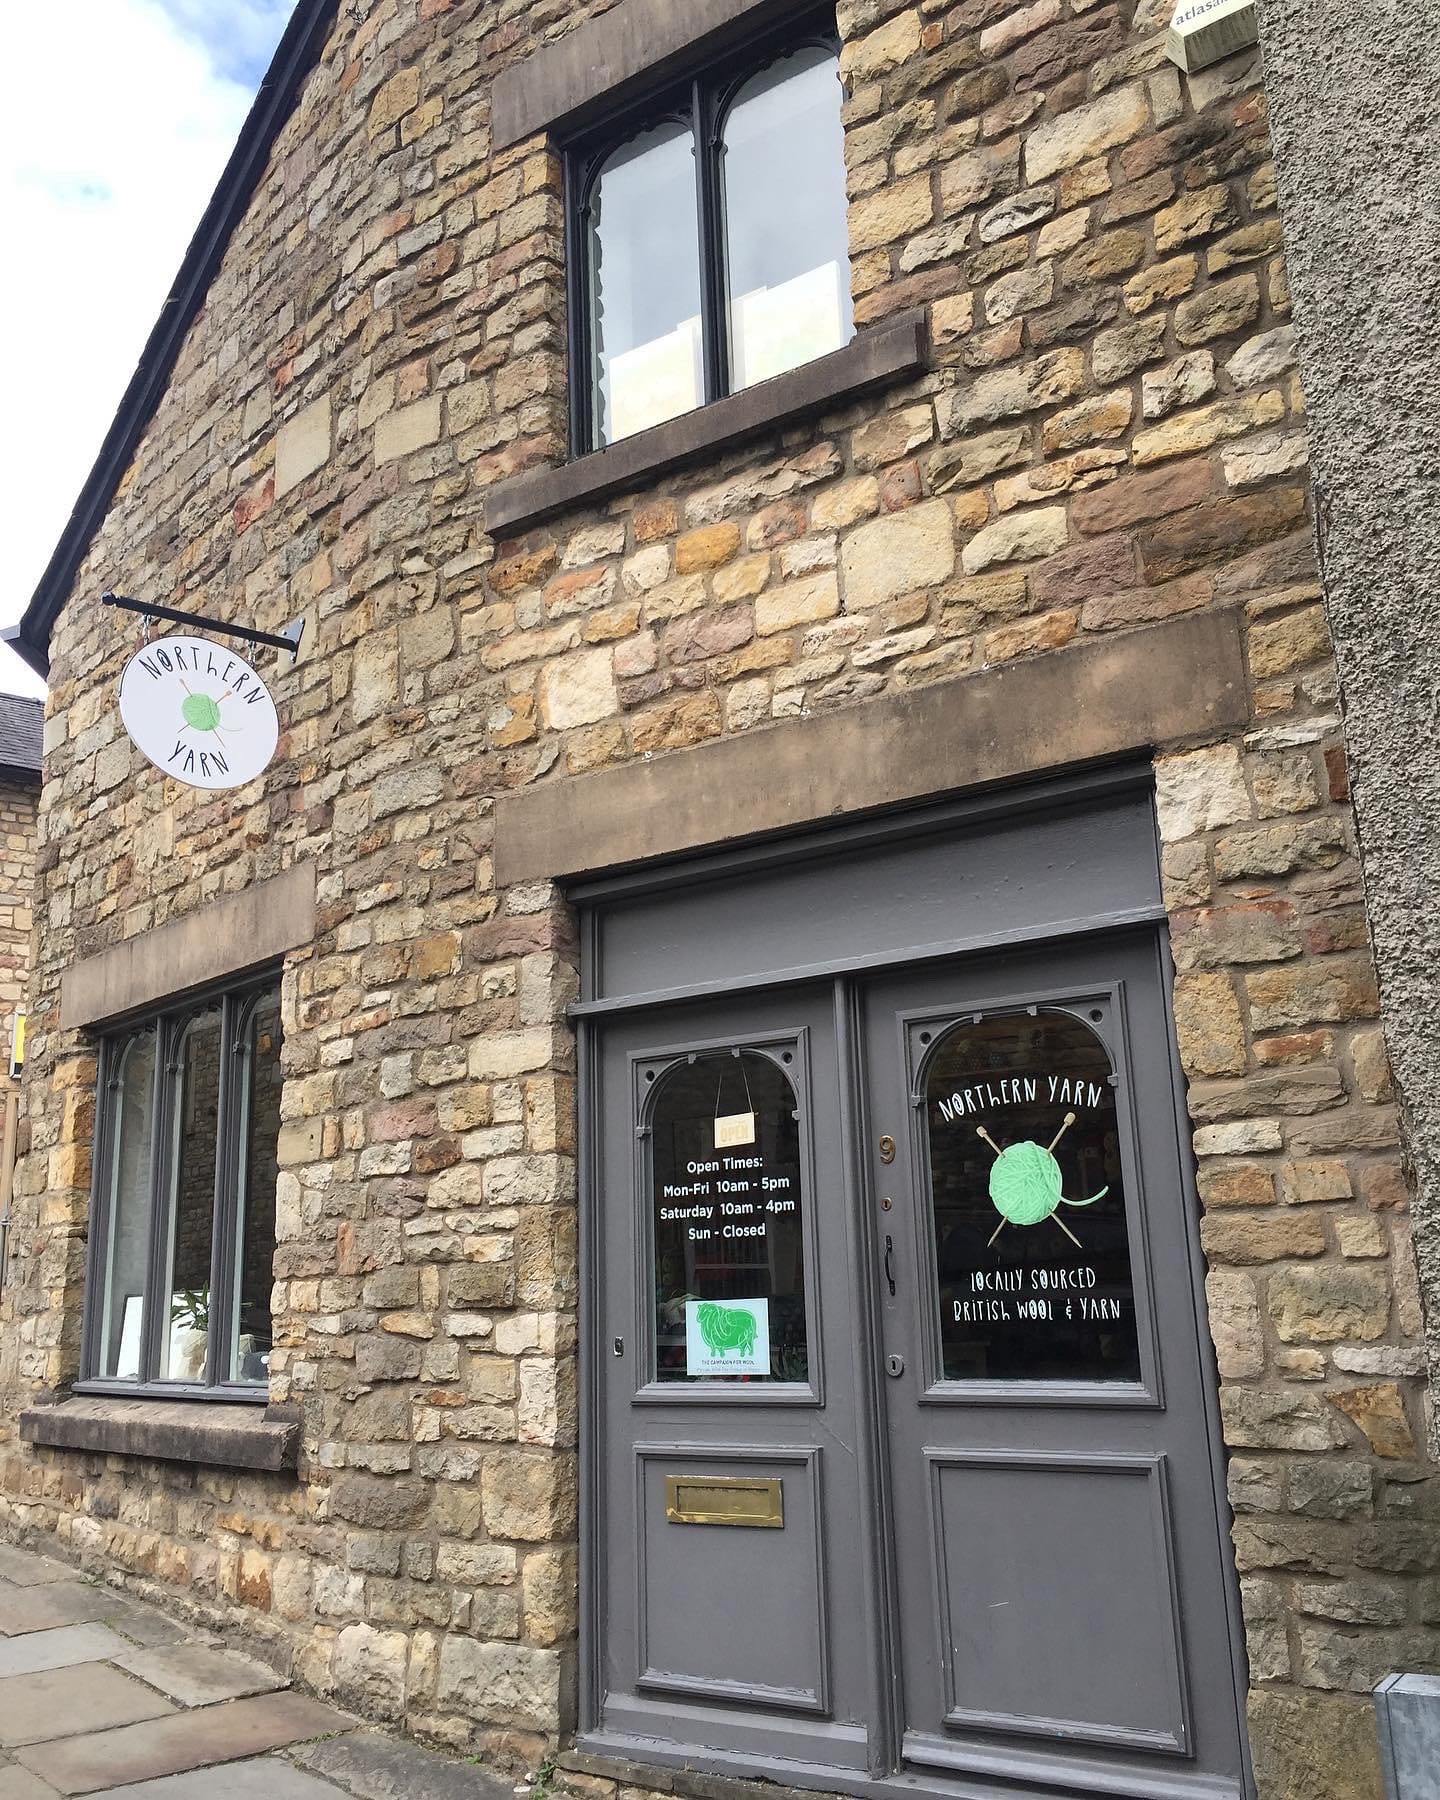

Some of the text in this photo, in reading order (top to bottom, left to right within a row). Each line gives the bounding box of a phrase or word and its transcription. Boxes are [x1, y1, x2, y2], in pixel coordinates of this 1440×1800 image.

[167, 740, 229, 777] YARN
[1048, 1075, 1102, 1108] YARN
[879, 1135, 896, 1165] 9
[686, 1156, 763, 1175] Open Times:
[663, 1181, 710, 1198] Mon-Fri
[716, 1180, 749, 1193] 10am
[761, 1176, 790, 1192] 5pm
[660, 1204, 713, 1219] Saturday
[719, 1202, 753, 1216] 10am
[765, 1199, 795, 1214] 4pm
[688, 1227, 711, 1240] Sun
[722, 1222, 766, 1238] Closed
[971, 1266, 1096, 1292] LOCALLY SOURCED
[1016, 1298, 1053, 1321] WOOL
[1079, 1297, 1120, 1320] YARN
